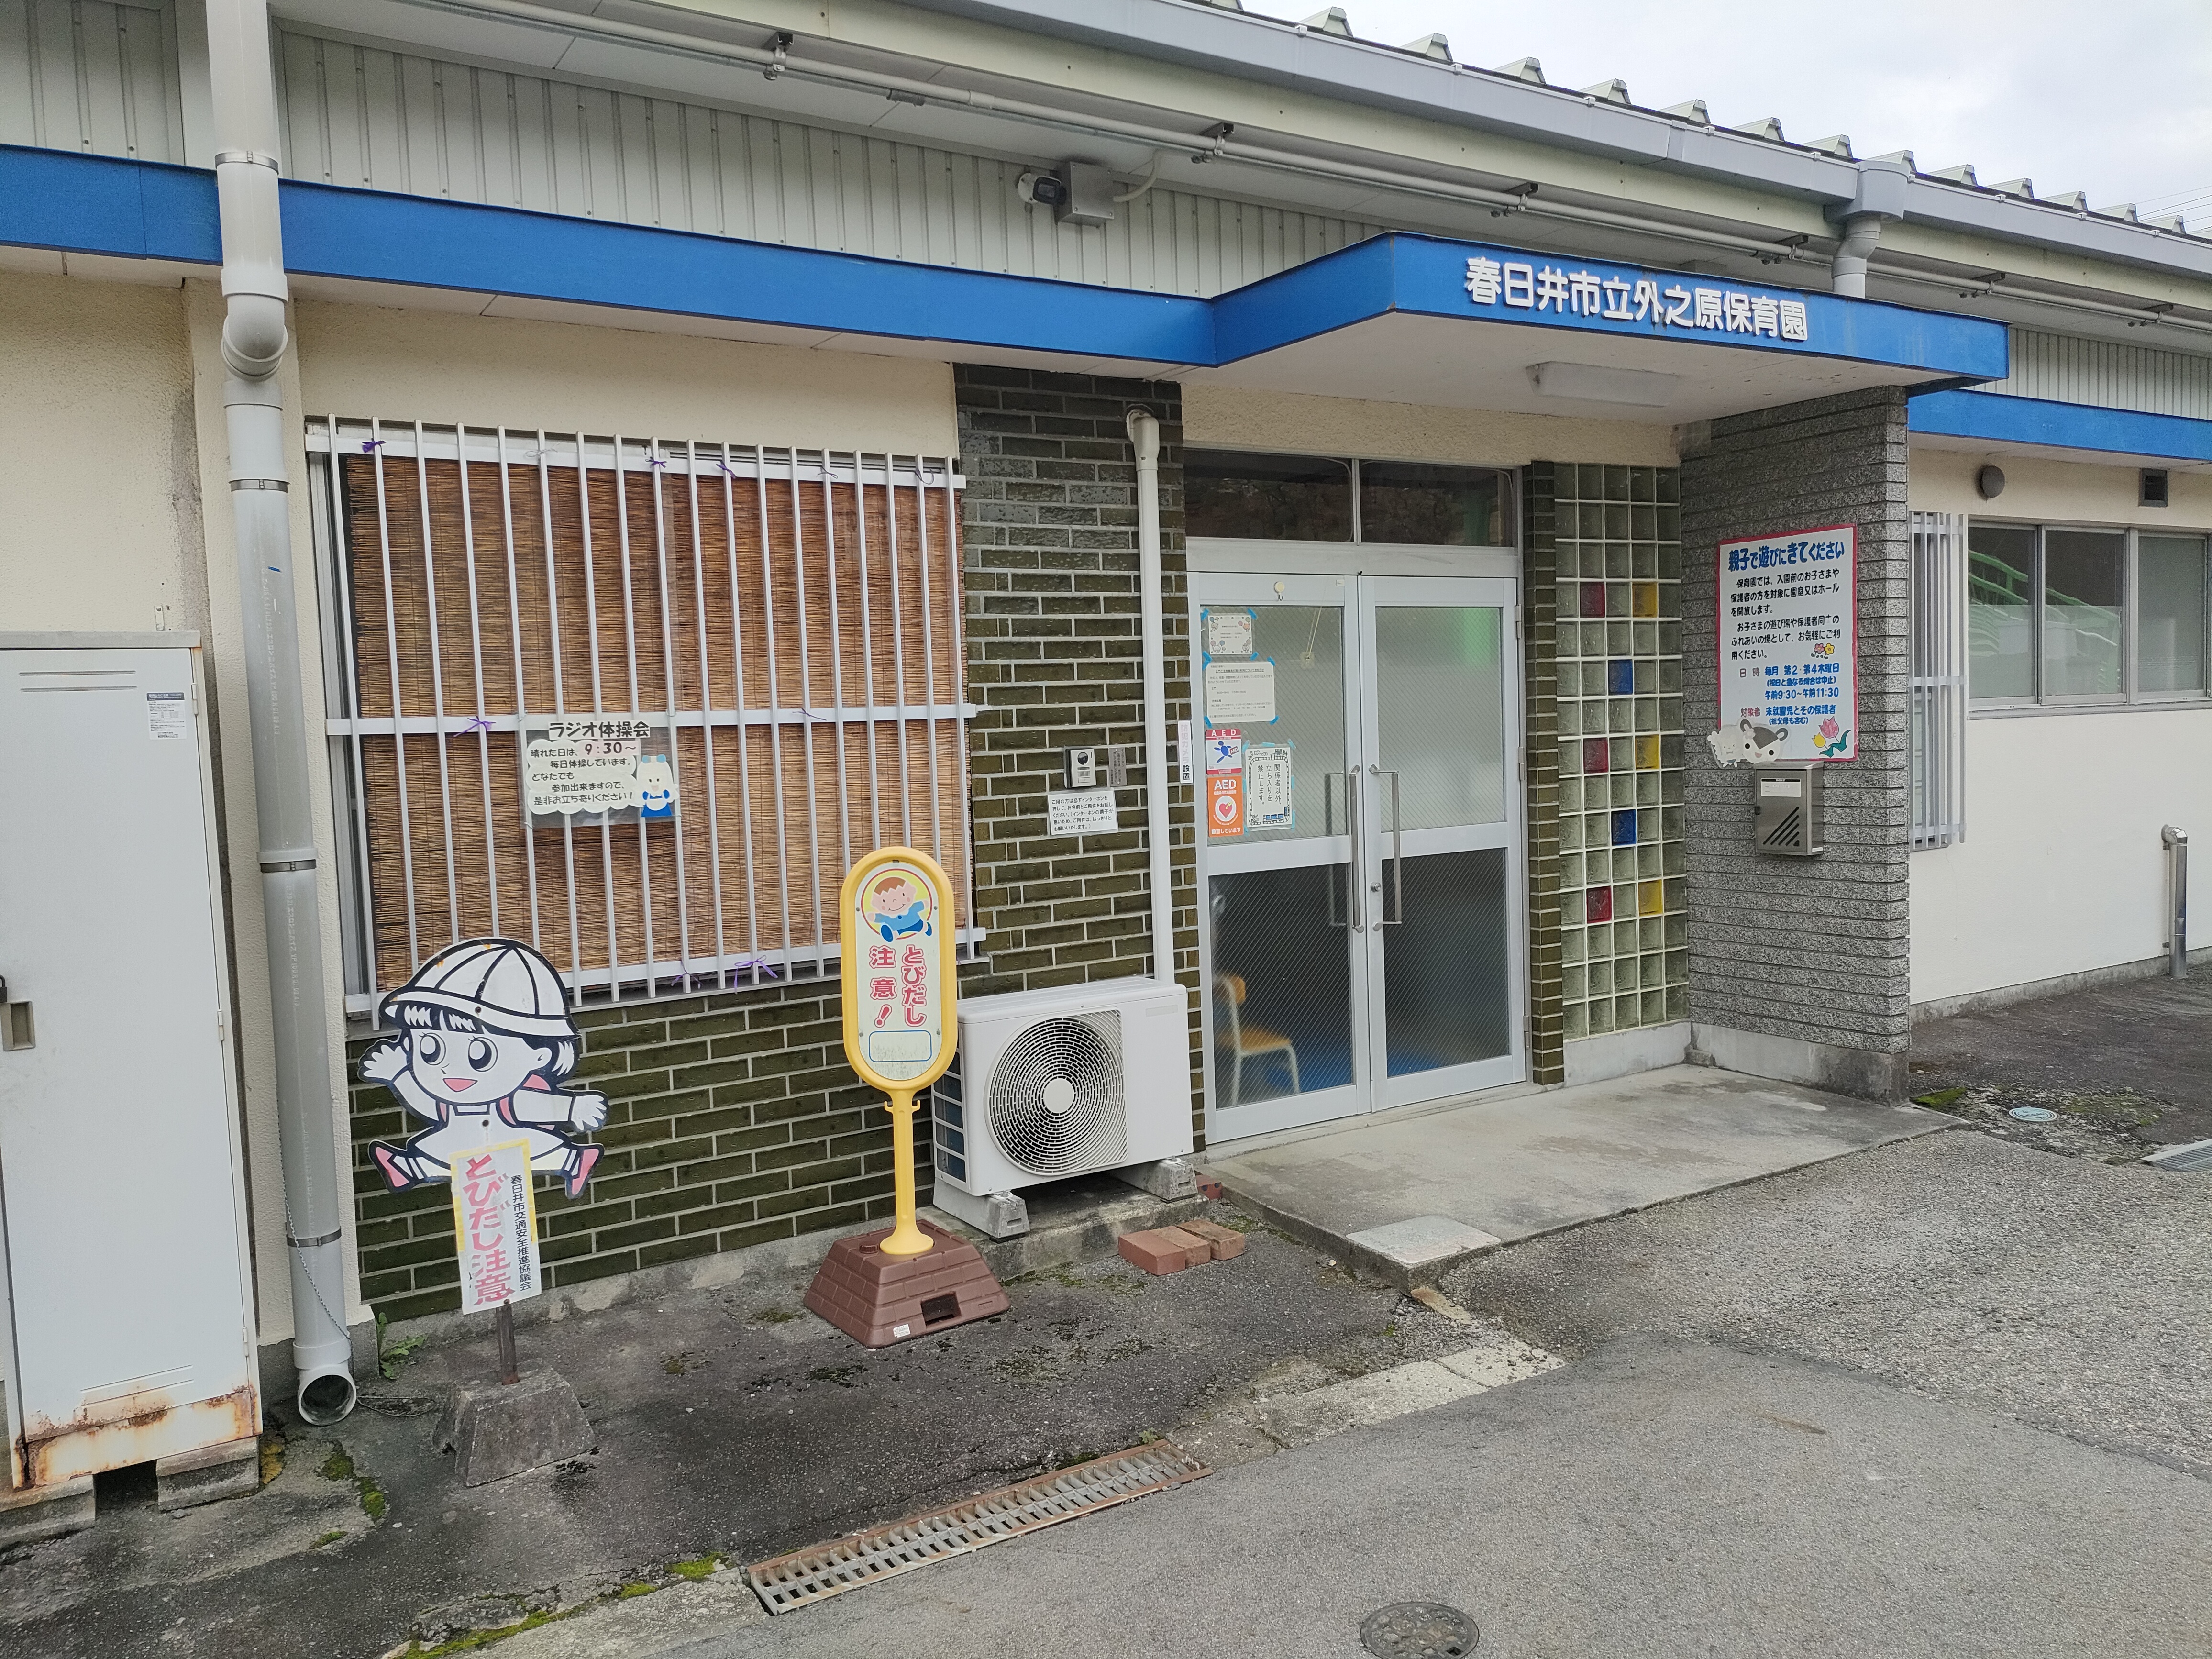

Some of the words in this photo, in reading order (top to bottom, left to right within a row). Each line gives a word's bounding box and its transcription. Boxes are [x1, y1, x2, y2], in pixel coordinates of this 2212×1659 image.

[1466, 256, 1808, 341] 春日井市立外之原保育園
[1728, 541, 1844, 572] 親子で遊びにきてください
[1736, 568, 1839, 589] 保育園では、入園前のお子さまや
[1730, 583, 1839, 603] 保護者の方を対象に園庭又はホール
[1731, 604, 1773, 617] を開放します。
[1731, 629, 1840, 646] ふれあいの場として、お気軽にご利
[1731, 649, 1767, 660] 用ください。
[1740, 707, 1760, 717] 対象者
[1766, 705, 1836, 717] 未就園児とその保護者
[549, 721, 650, 738] ラジオ体操会
[531, 748, 578, 758] 晴れた日は、
[550, 758, 631, 769] 毎日体操しています。
[532, 772, 574, 782] どなたでも
[552, 781, 625, 793] 参加出来ますので、
[1214, 779, 1237, 790] AED
[1052, 796, 1108, 804] ご用の方は必ずインターホンを
[1052, 803, 1113, 811] 押して、お名前とご用件をお話し
[1053, 816, 1112, 824] 悪いため、ご用件は、はっきりと
[902, 944, 927, 1028] とびだし
[463, 1153, 516, 1305] とびだし注意
[510, 1174, 531, 1291] 春日井市交通安全推進協議会
